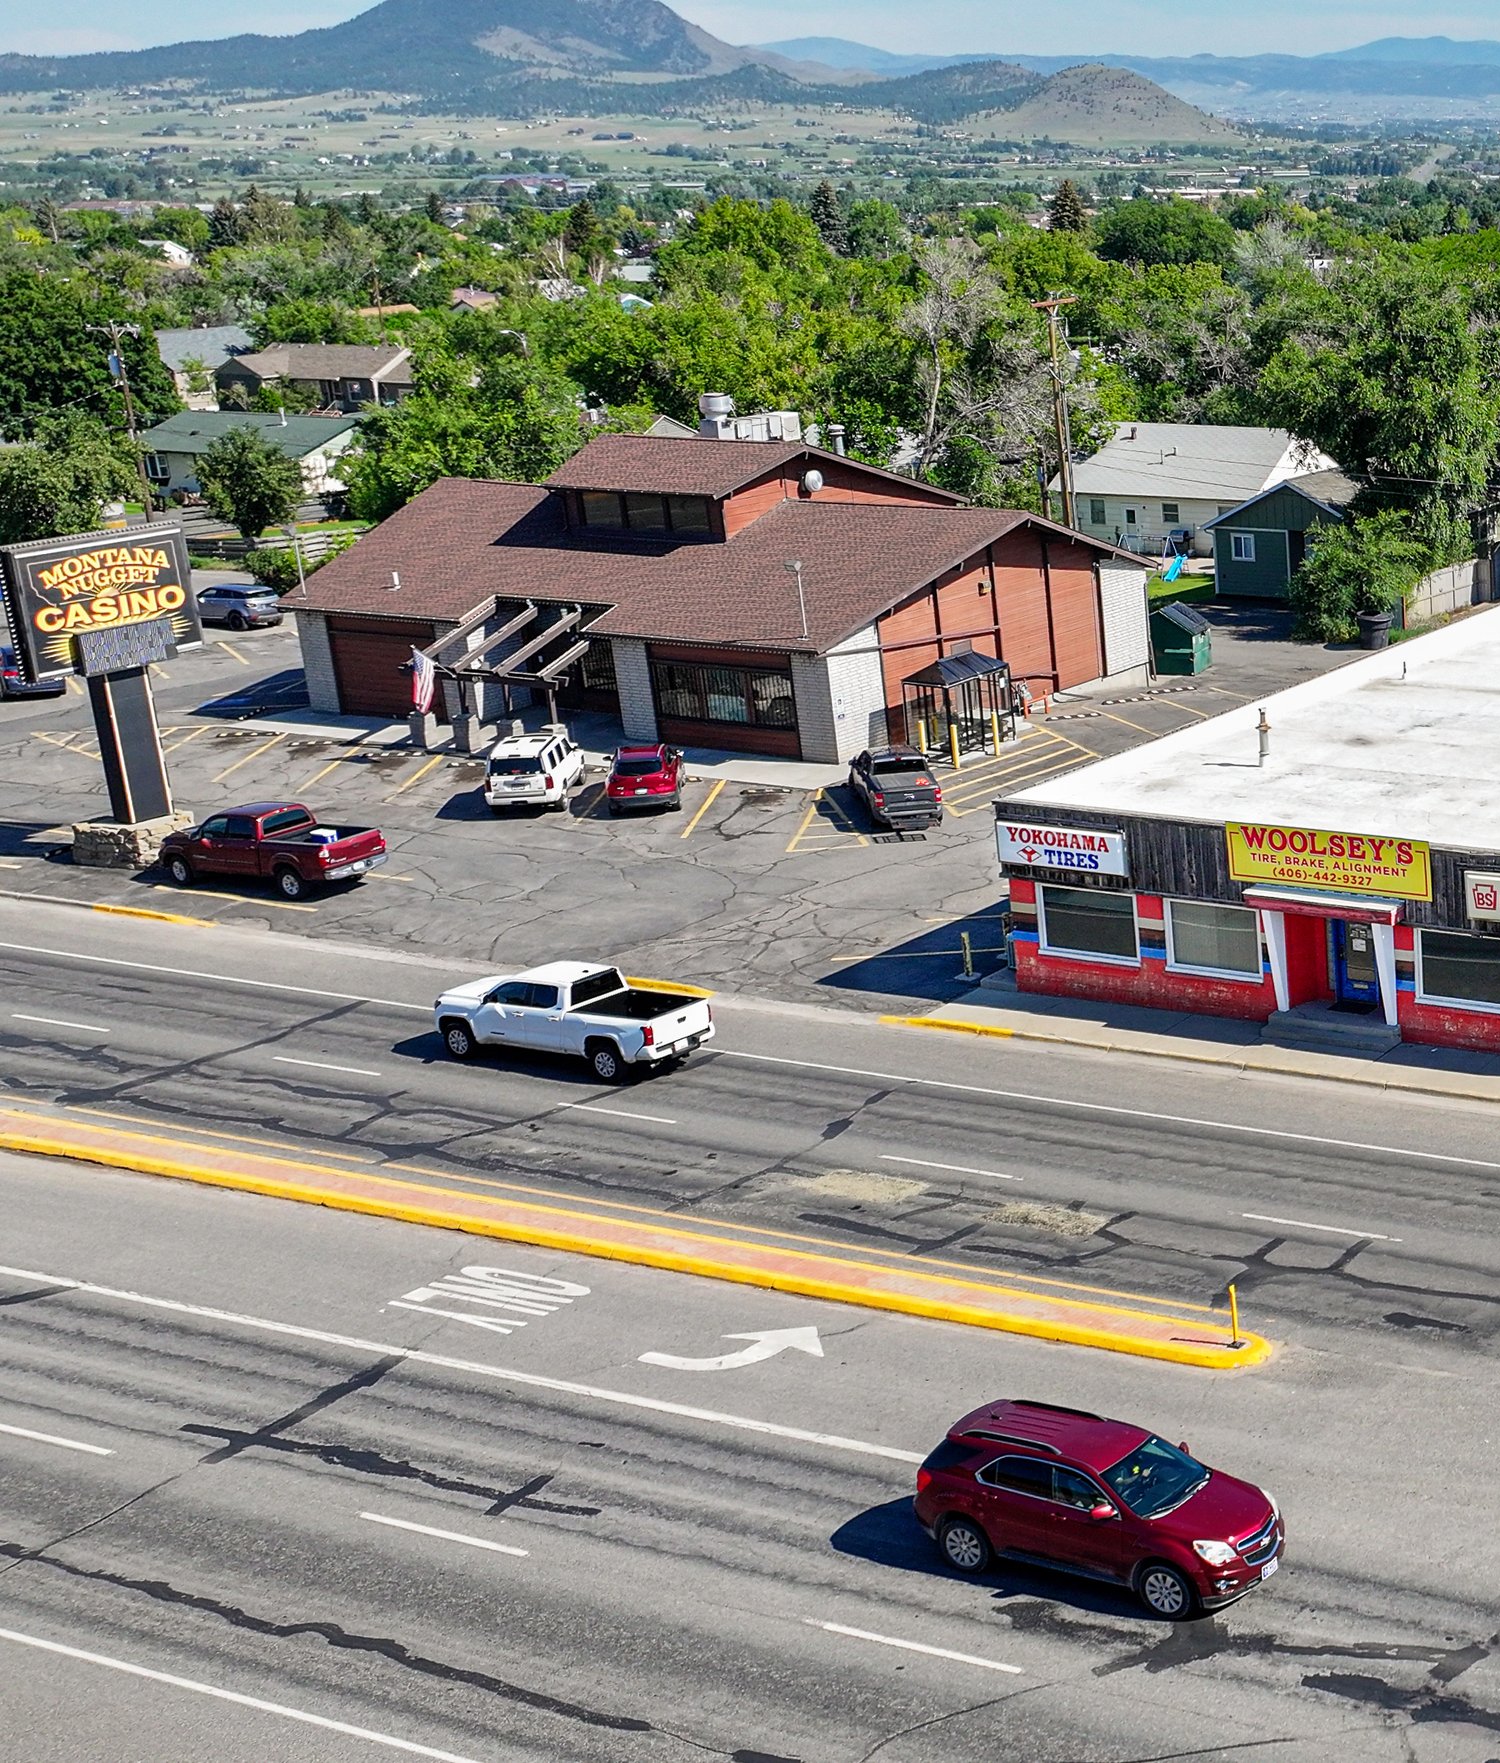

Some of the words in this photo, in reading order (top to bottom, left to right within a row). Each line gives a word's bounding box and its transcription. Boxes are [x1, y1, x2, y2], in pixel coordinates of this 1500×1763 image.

[38, 547, 171, 590] MONTANA
[58, 565, 160, 600] NUGGET
[34, 584, 186, 632] CASINO
[1006, 826, 1110, 853] YOKOHAMA
[1239, 825, 1414, 866] WOOLSEY'S
[1044, 849, 1099, 870] TIRES
[1250, 852, 1281, 865] TIRE,
[1285, 856, 1329, 870] BRAKE,
[1333, 861, 1408, 878] ALIGNMENT
[1272, 867, 1372, 886] (406)-442-9327
[1476, 892, 1493, 907] BS
[387, 1265, 592, 1335] ONLY
